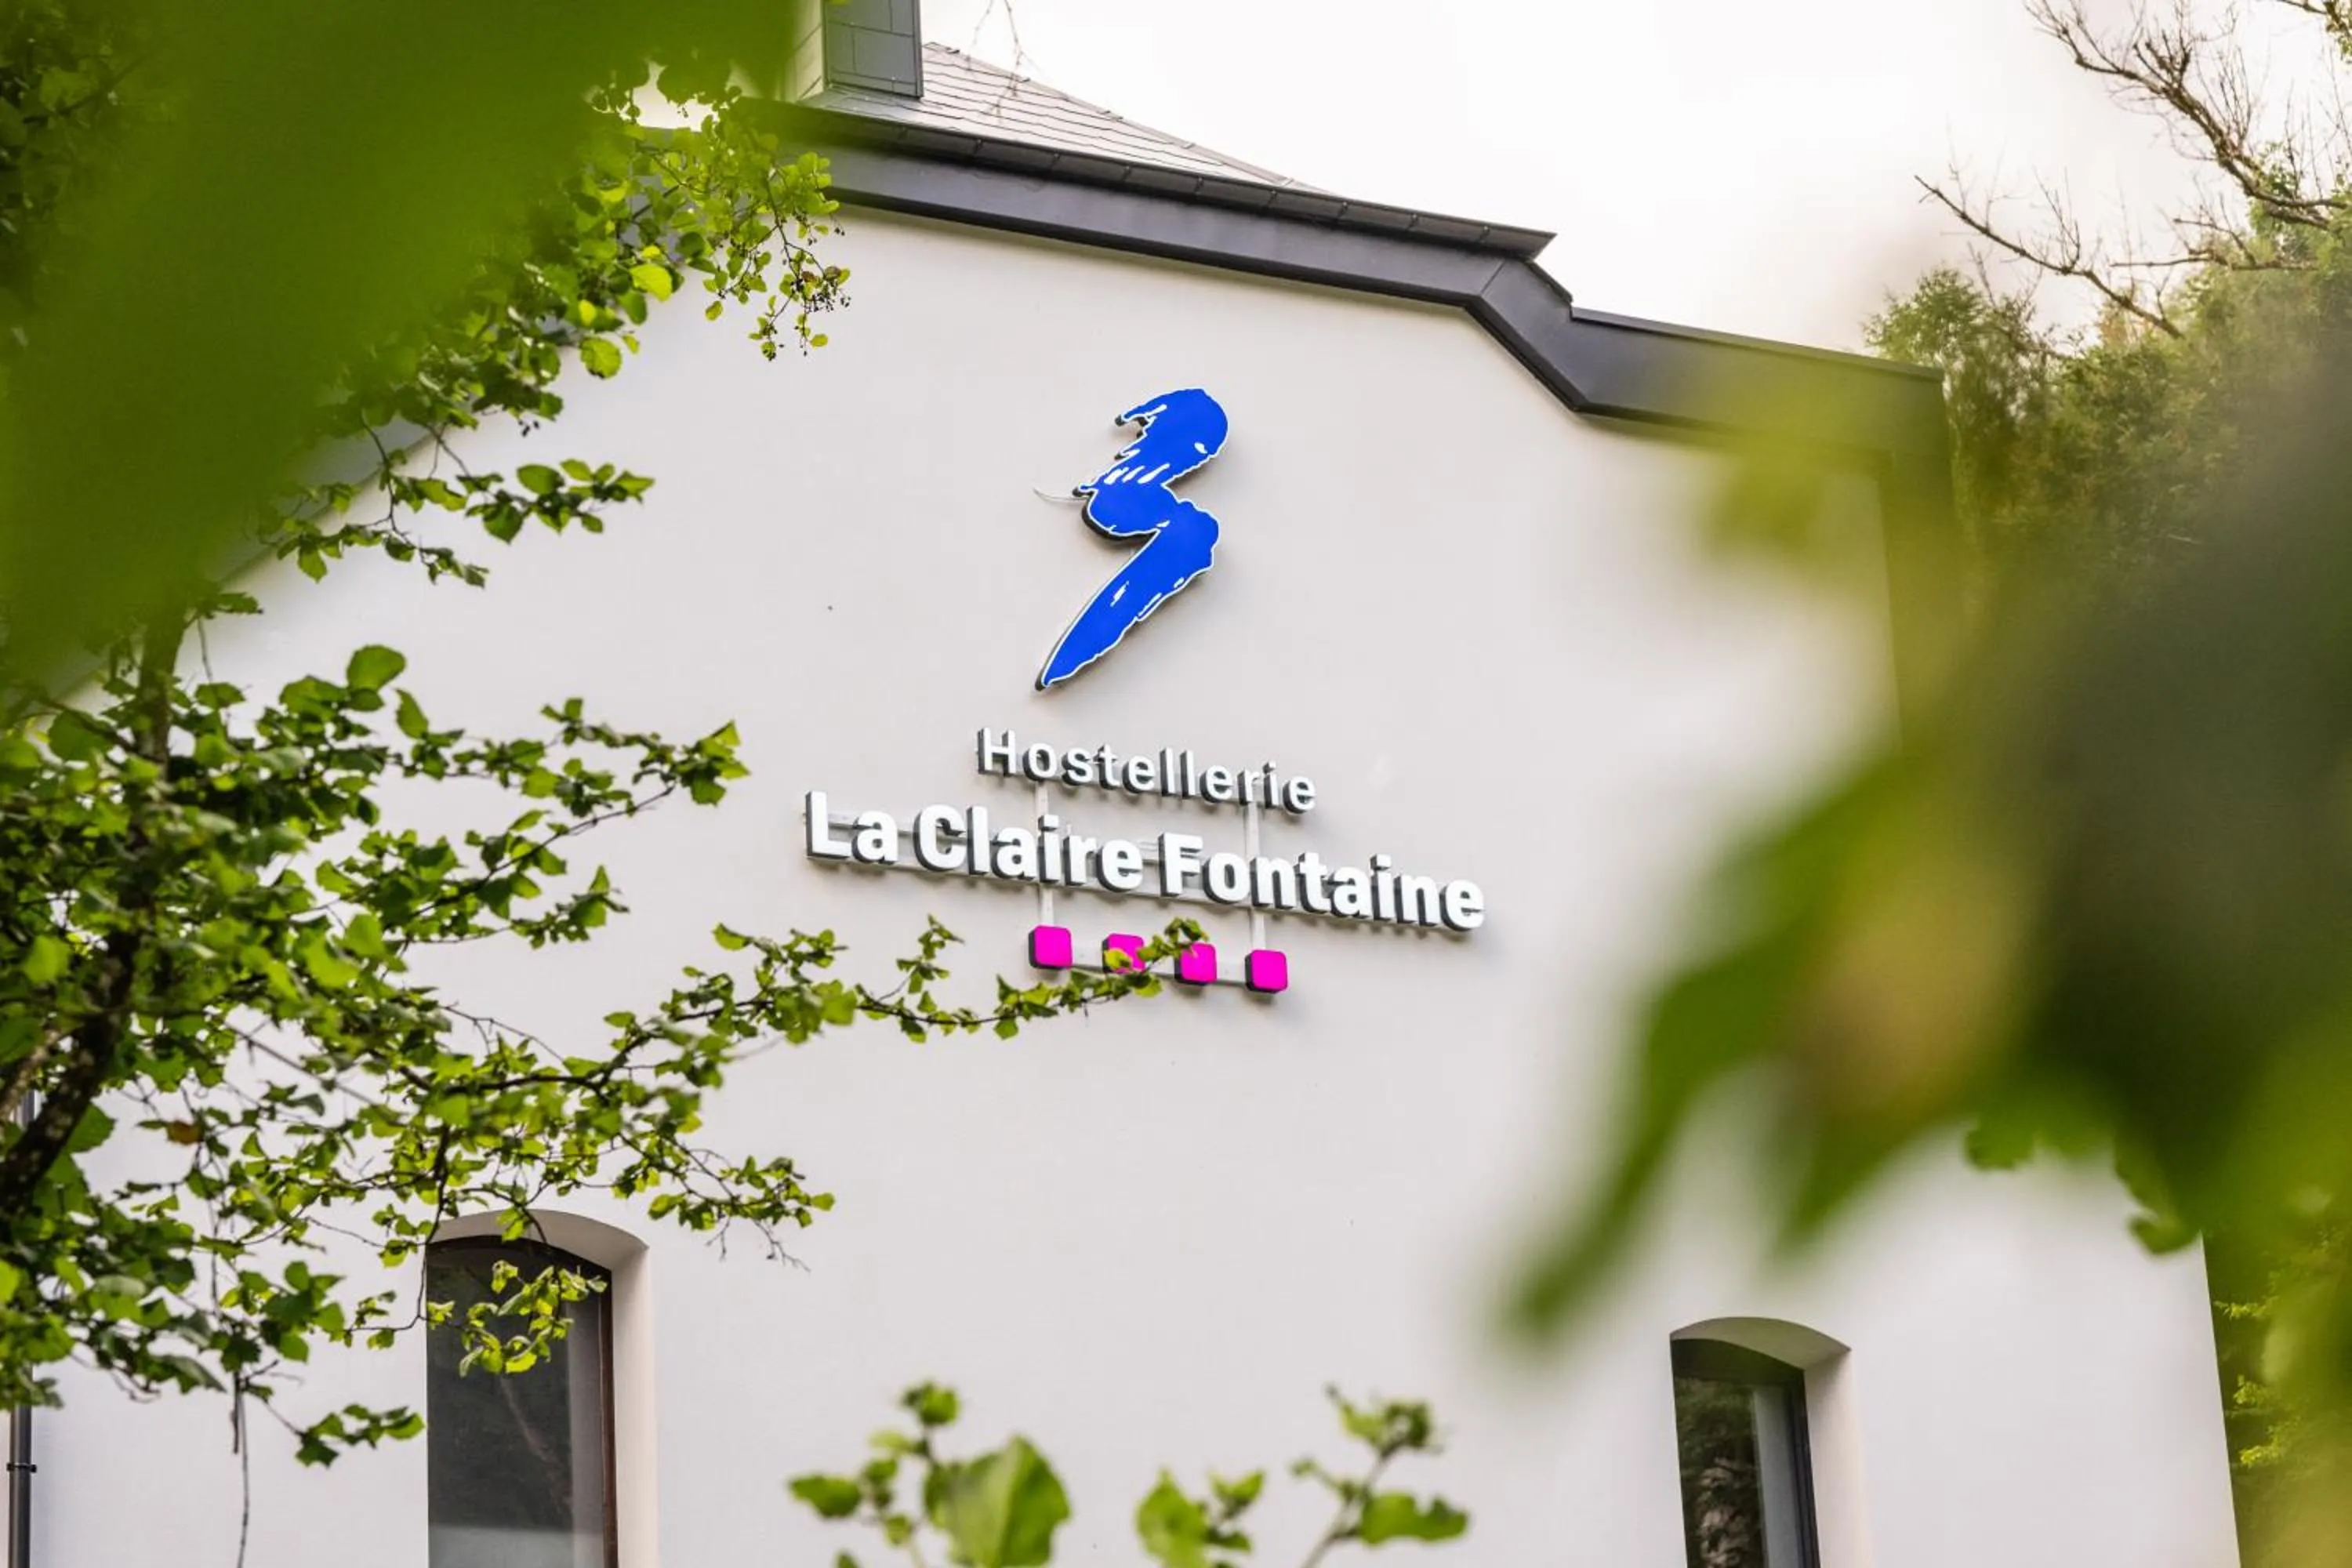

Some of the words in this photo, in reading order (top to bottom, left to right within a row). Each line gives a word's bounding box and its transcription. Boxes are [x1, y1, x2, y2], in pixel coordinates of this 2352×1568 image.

[978, 727, 1316, 814] Hostellerie
[806, 790, 898, 864] La
[914, 804, 1144, 891] Claire
[1158, 832, 1485, 931] Fontaine
